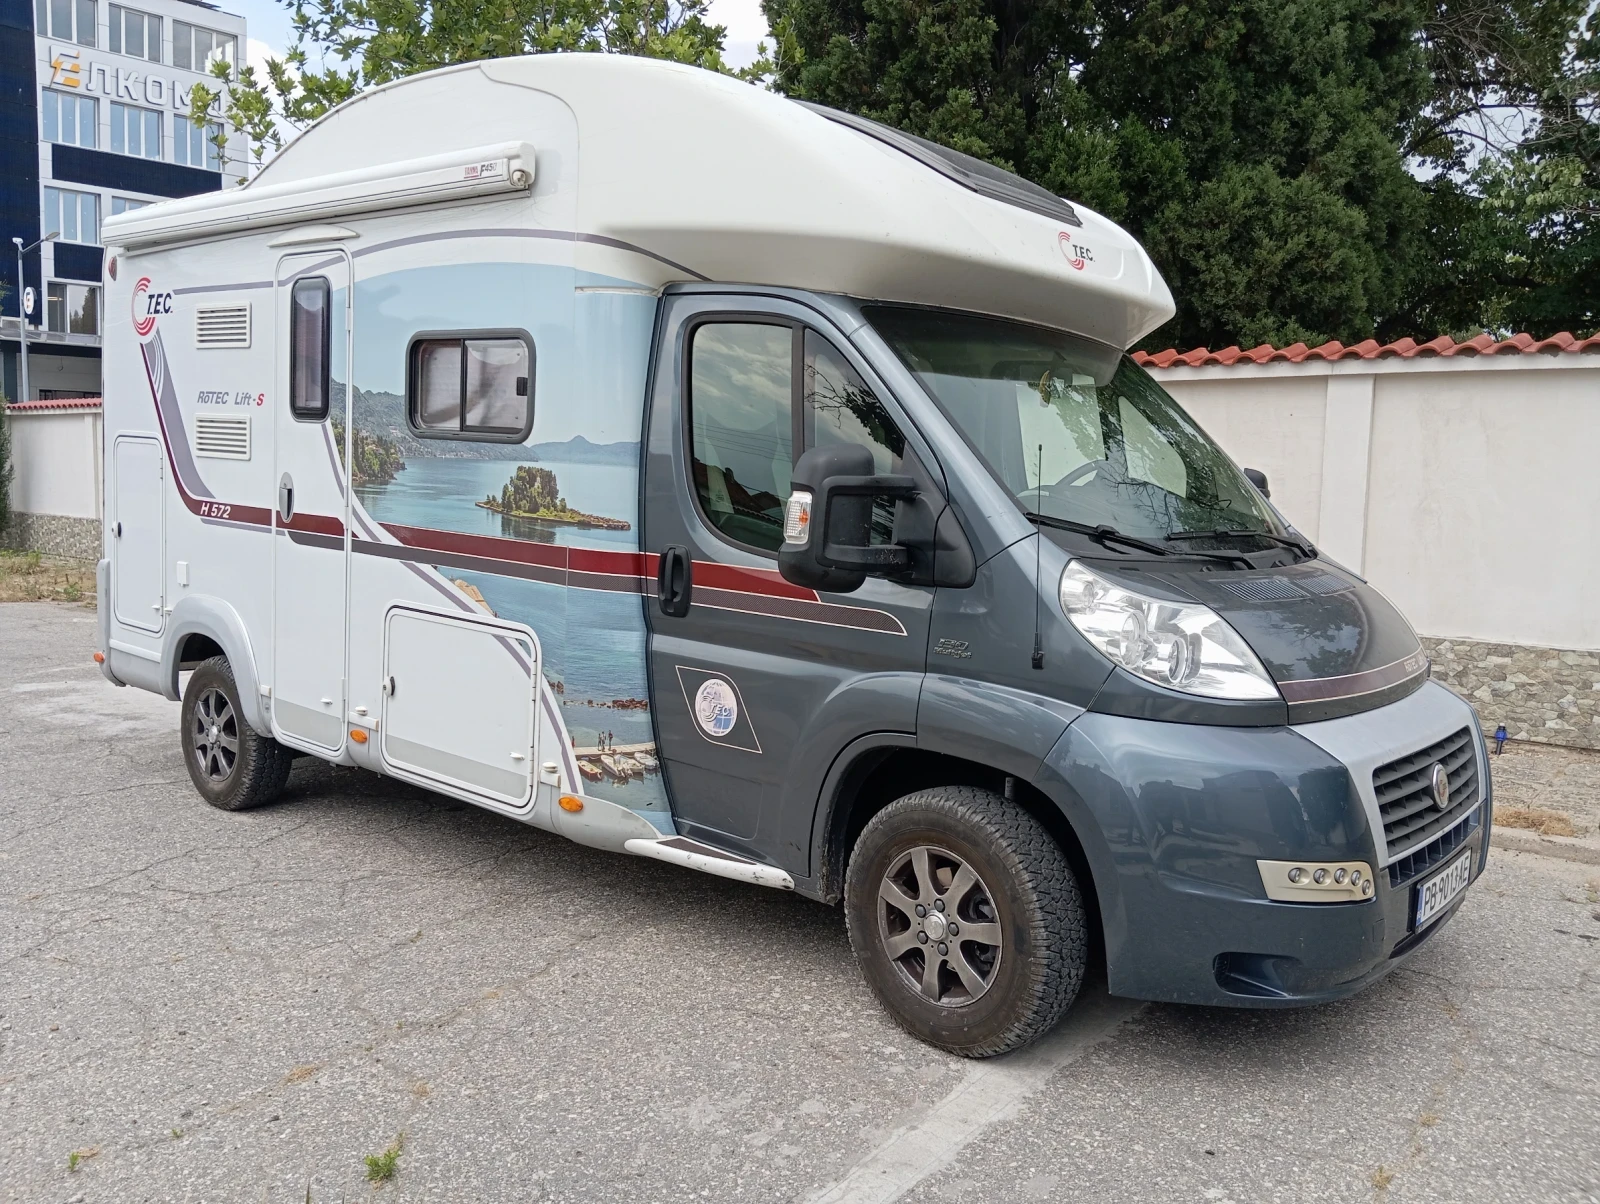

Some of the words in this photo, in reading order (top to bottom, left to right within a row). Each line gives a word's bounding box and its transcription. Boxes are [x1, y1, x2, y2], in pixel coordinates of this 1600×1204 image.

[147, 292, 173, 315] T.E.C.
[200, 502, 210, 515] H
[210, 503, 231, 519] 572
